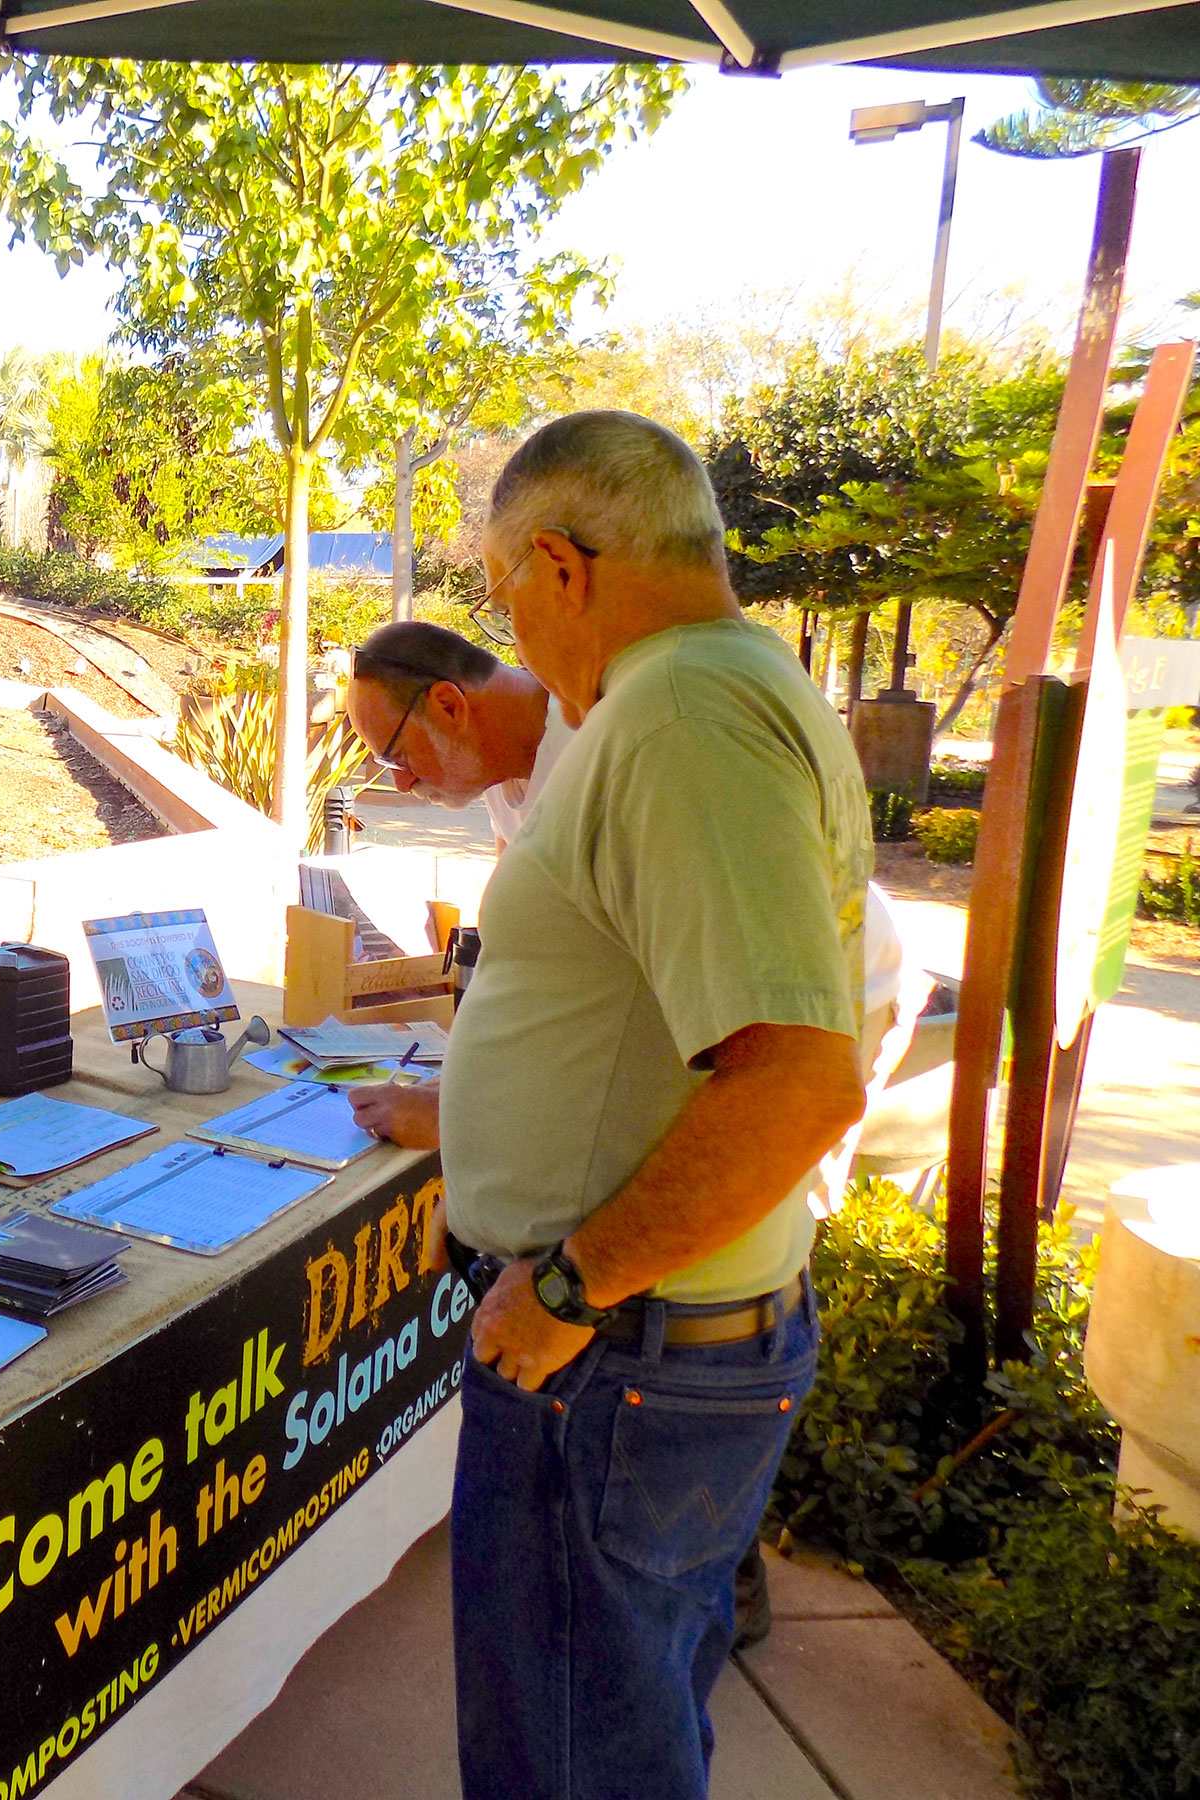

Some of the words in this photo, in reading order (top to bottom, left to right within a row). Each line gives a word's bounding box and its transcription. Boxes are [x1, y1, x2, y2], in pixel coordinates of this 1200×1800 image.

[126, 952, 166, 970] COUNTY
[130, 968, 149, 983] SAN
[151, 963, 180, 979] DIEGO
[135, 978, 184, 998] RECYCLING
[185, 1327, 287, 1465] talk
[302, 1176, 446, 1368] DIRT
[54, 1510, 178, 1658] with
[196, 1448, 266, 1548] the
[282, 1317, 418, 1471] Solana
